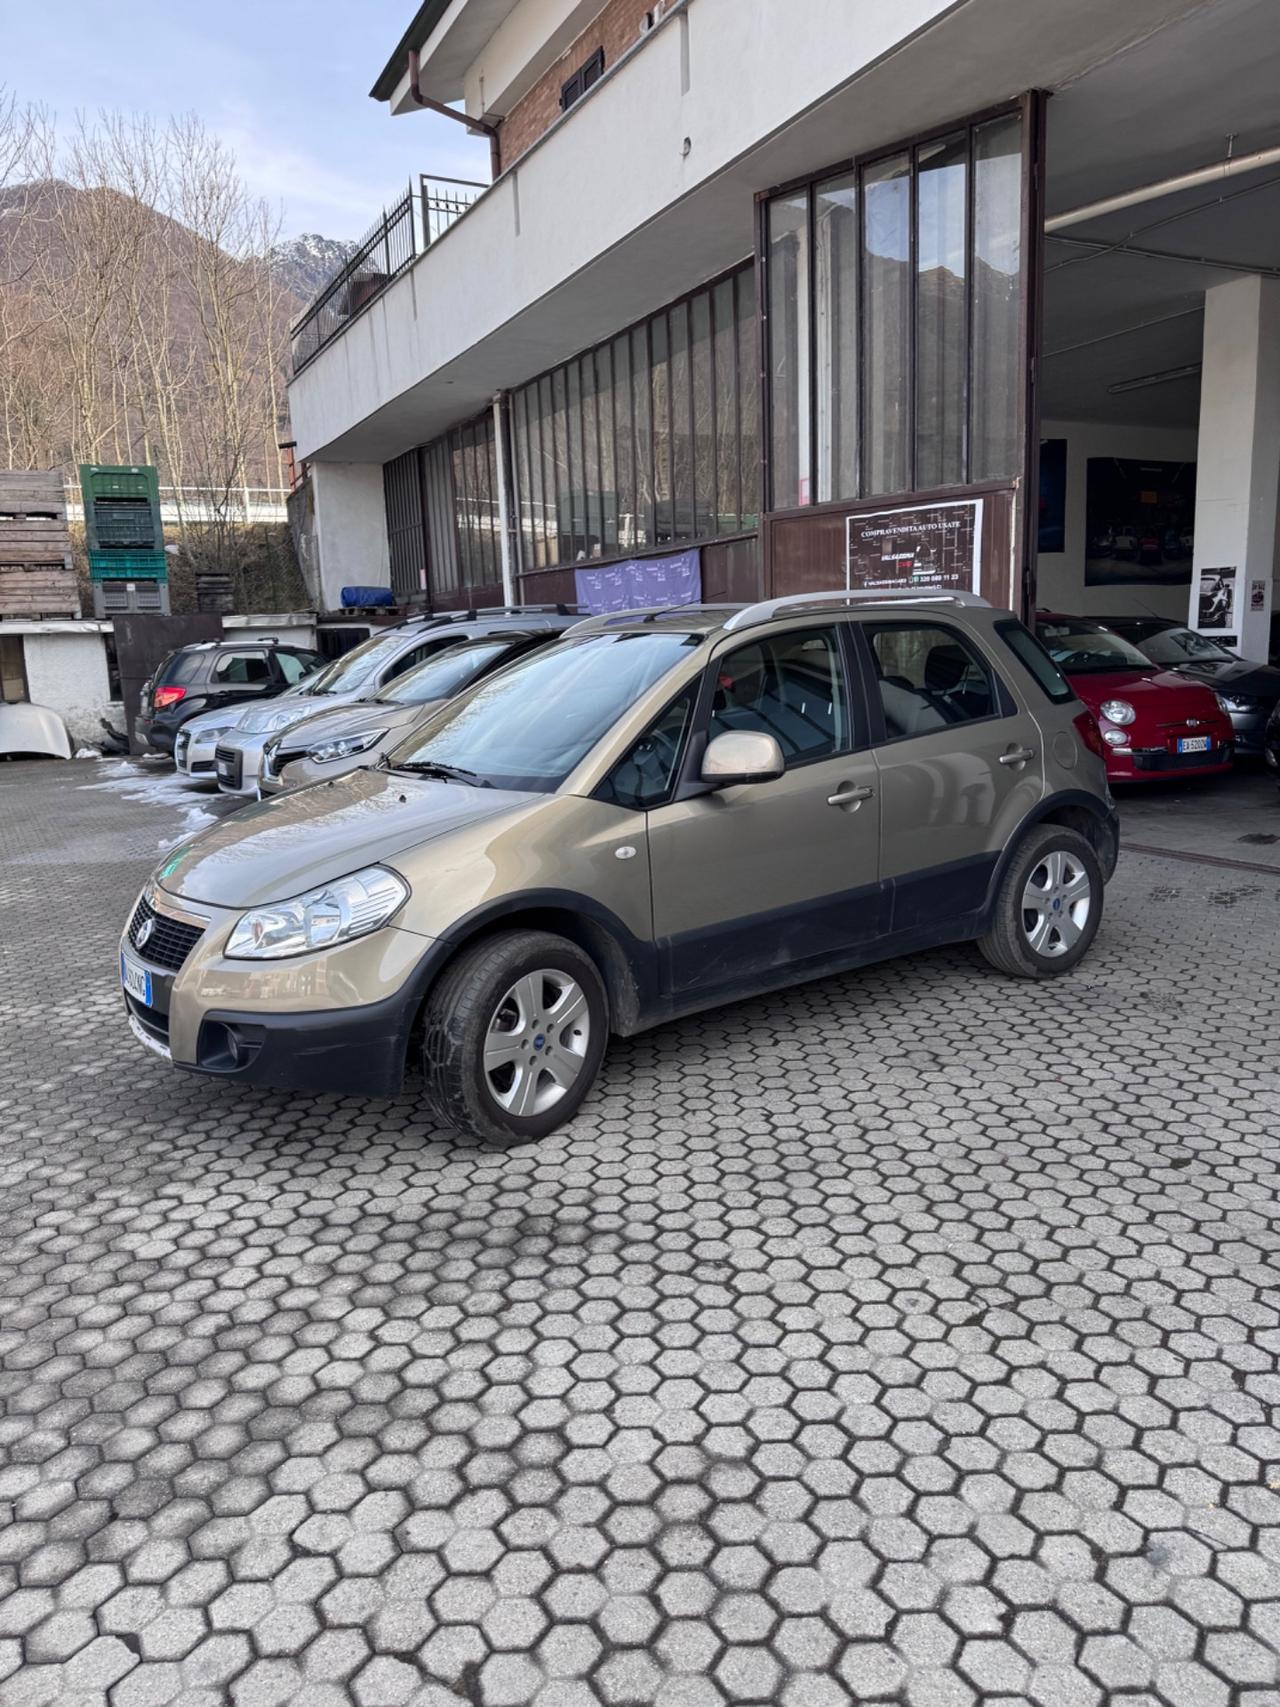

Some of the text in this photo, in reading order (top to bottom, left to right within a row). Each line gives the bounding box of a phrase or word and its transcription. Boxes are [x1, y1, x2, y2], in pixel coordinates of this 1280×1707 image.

[861, 521, 961, 538] COMPRAVENDITA AUTO USATE
